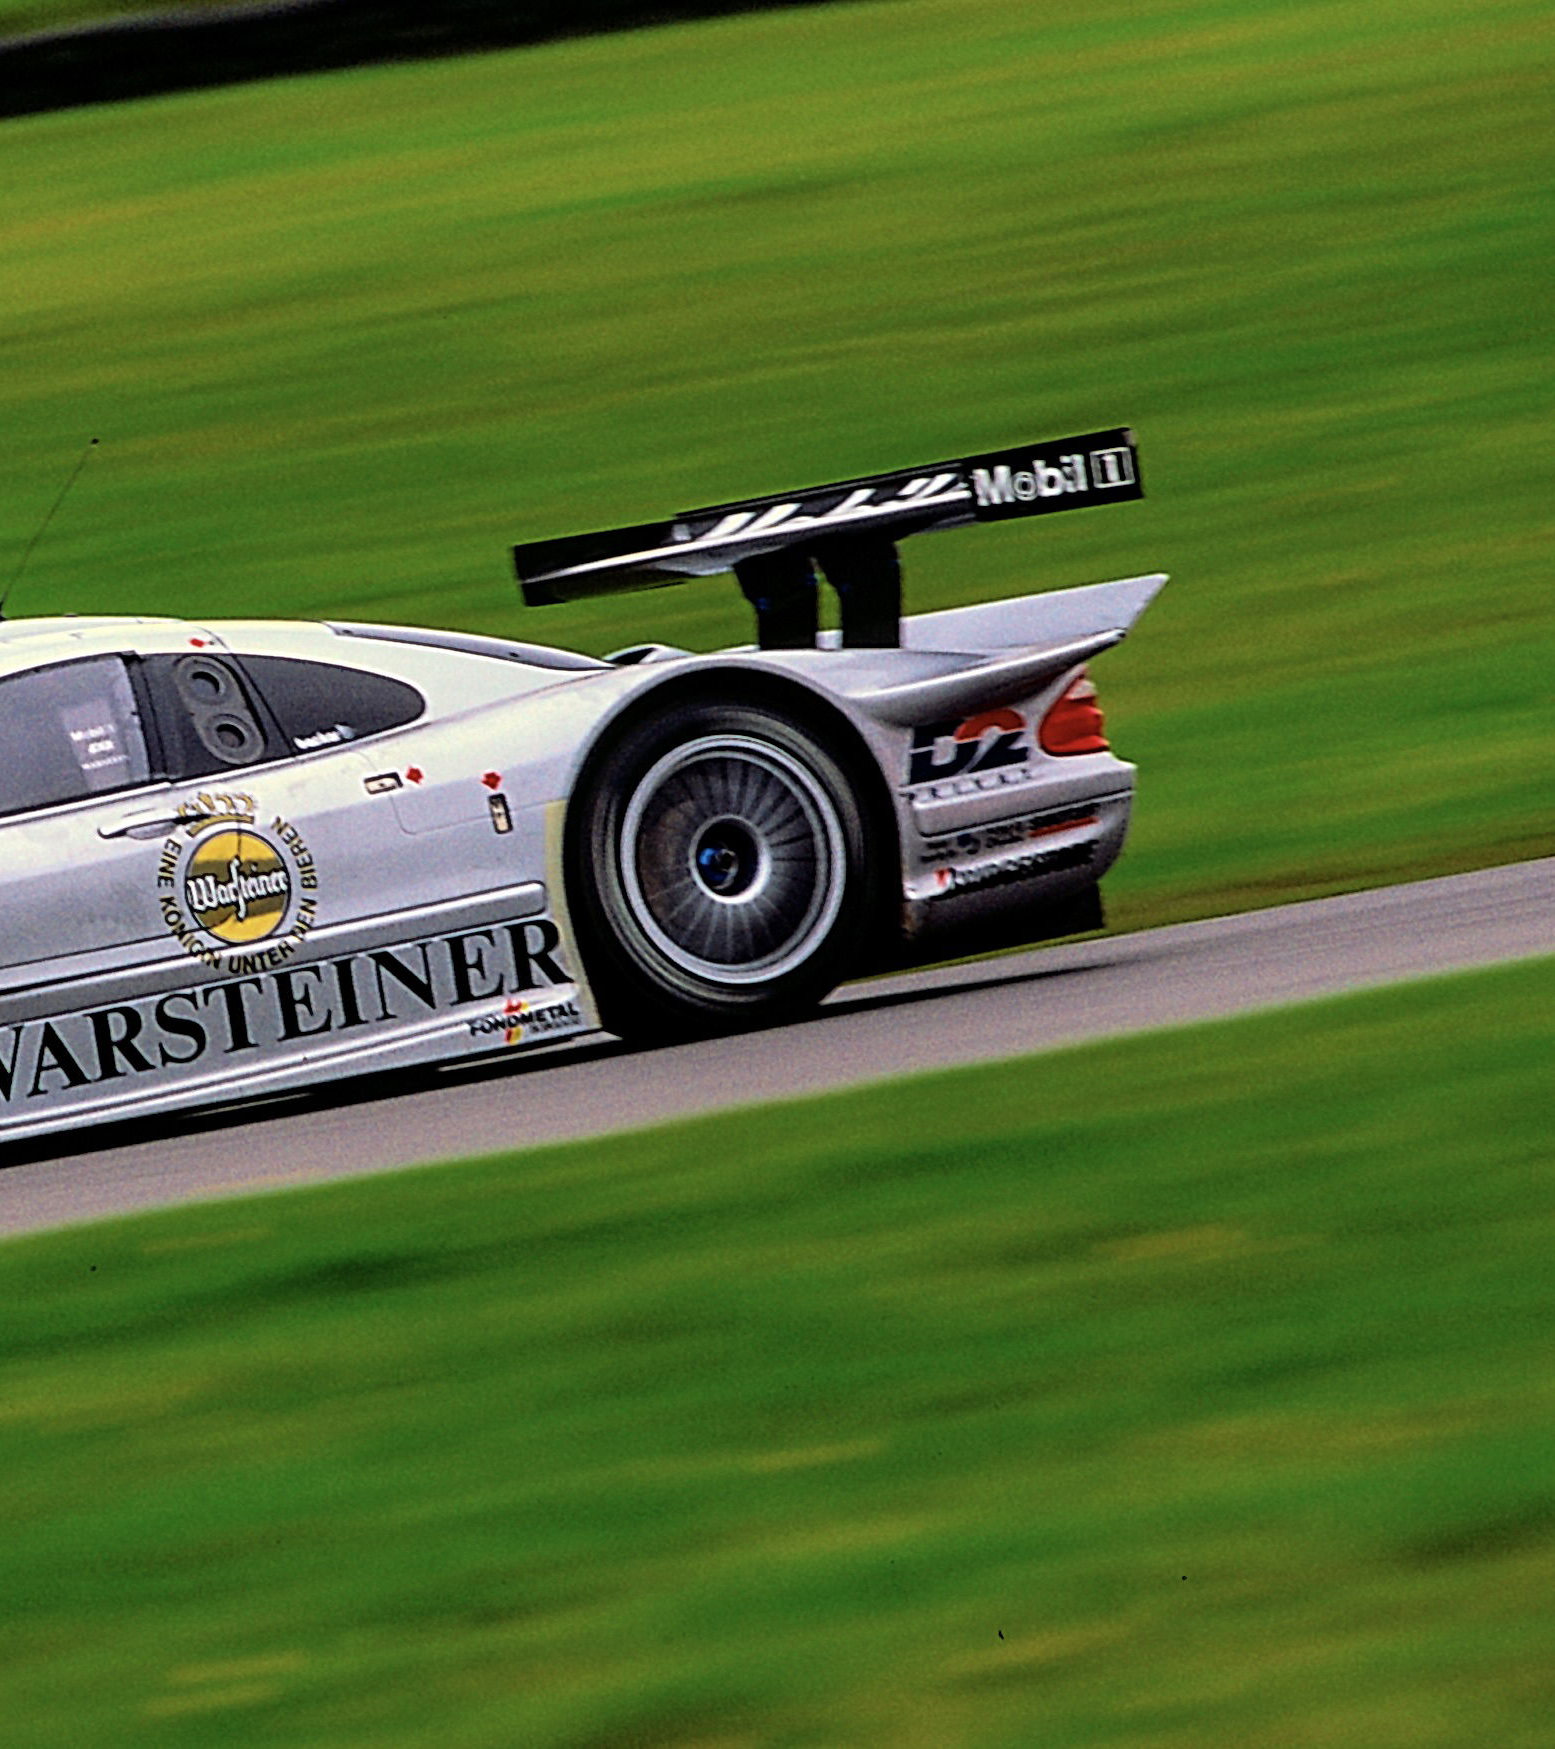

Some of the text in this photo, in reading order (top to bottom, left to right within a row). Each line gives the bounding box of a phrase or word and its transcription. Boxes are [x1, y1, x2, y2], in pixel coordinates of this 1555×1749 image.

[972, 454, 1088, 507] Mobil
[157, 838, 183, 889] EINE
[228, 940, 296, 974] UNTER
[271, 815, 319, 891] BIEREN
